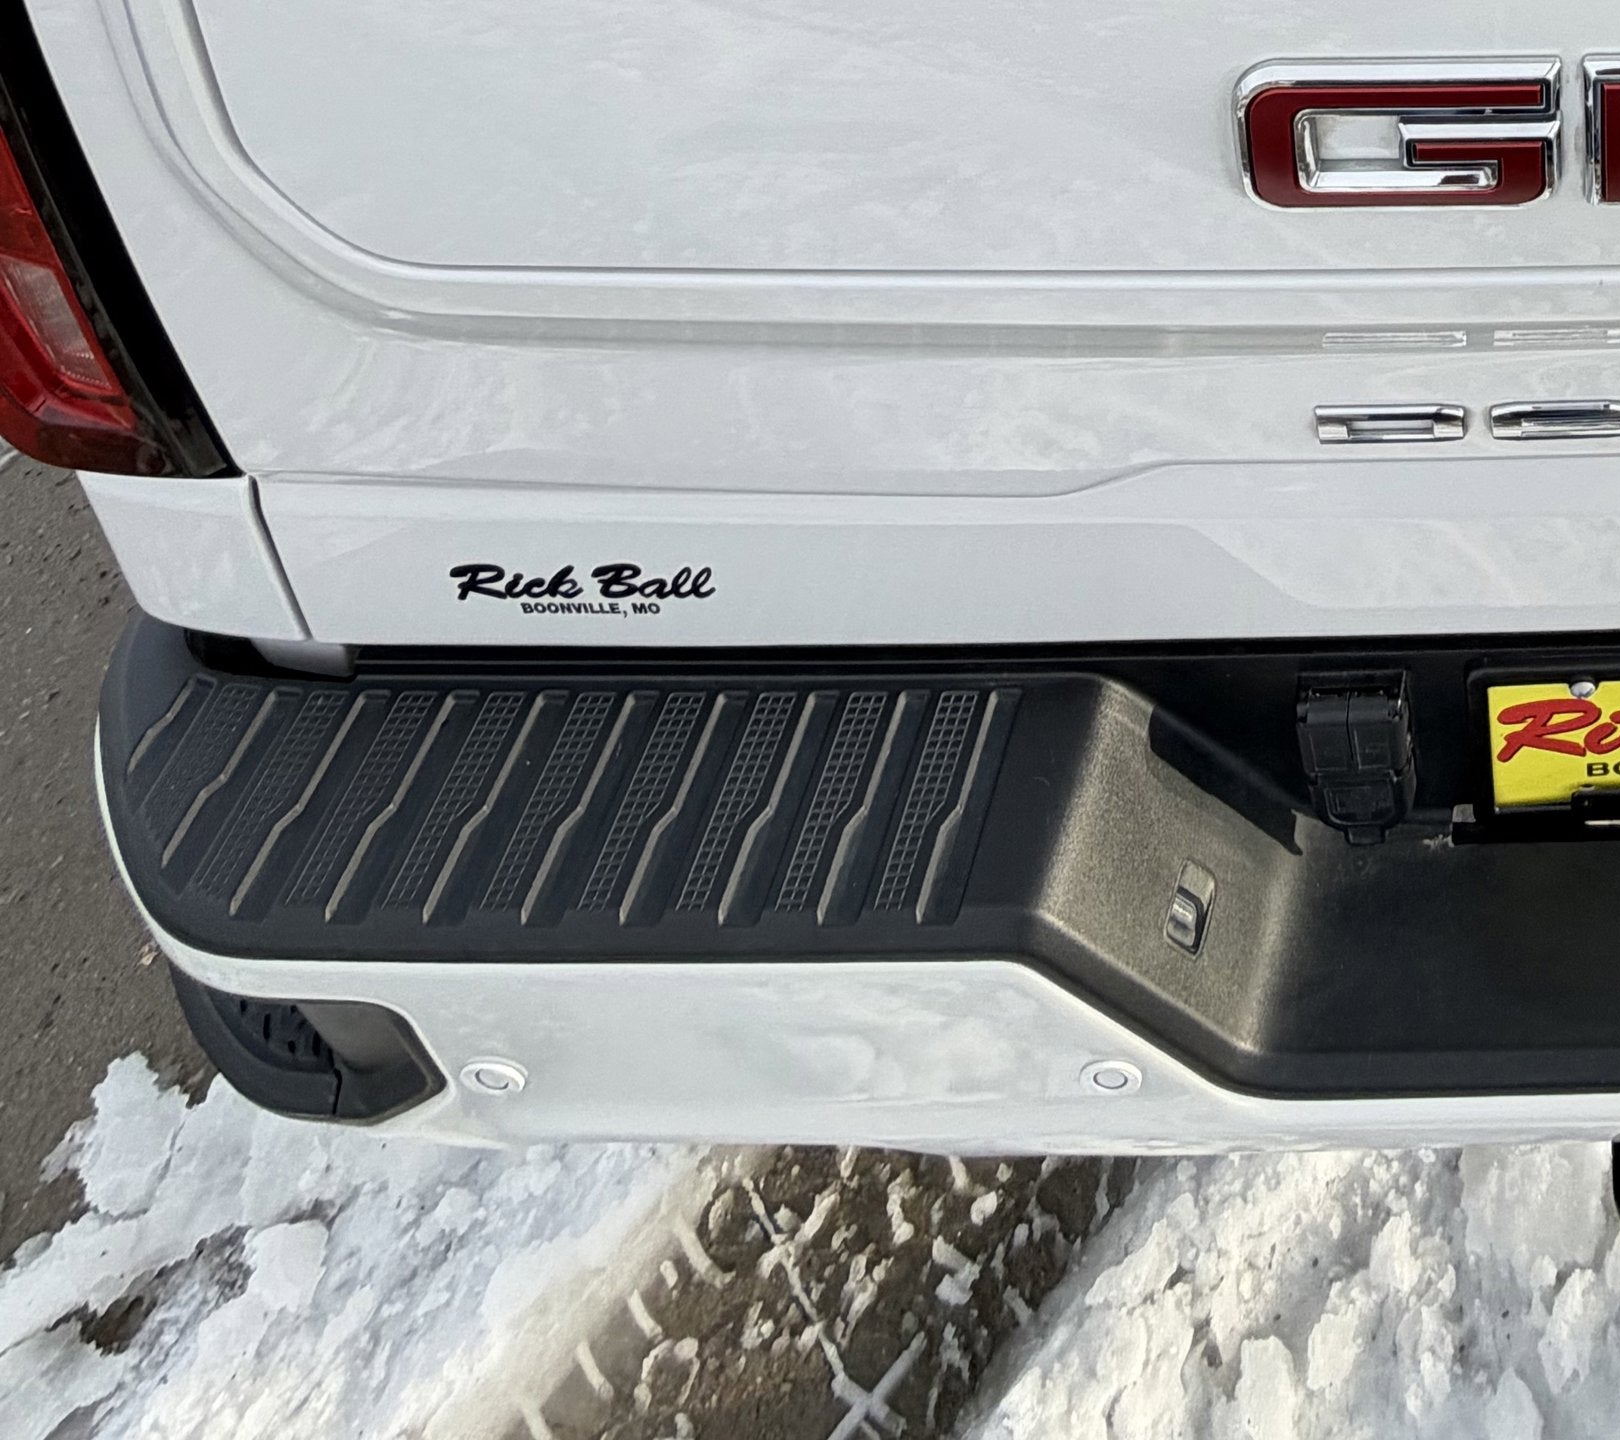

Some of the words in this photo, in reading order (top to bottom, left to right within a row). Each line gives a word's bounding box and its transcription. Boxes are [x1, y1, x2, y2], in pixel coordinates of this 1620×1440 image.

[450, 563, 584, 600] Rick
[591, 563, 716, 599] Ball
[520, 602, 628, 618] BOONVILLE,
[632, 602, 661, 615] MO
